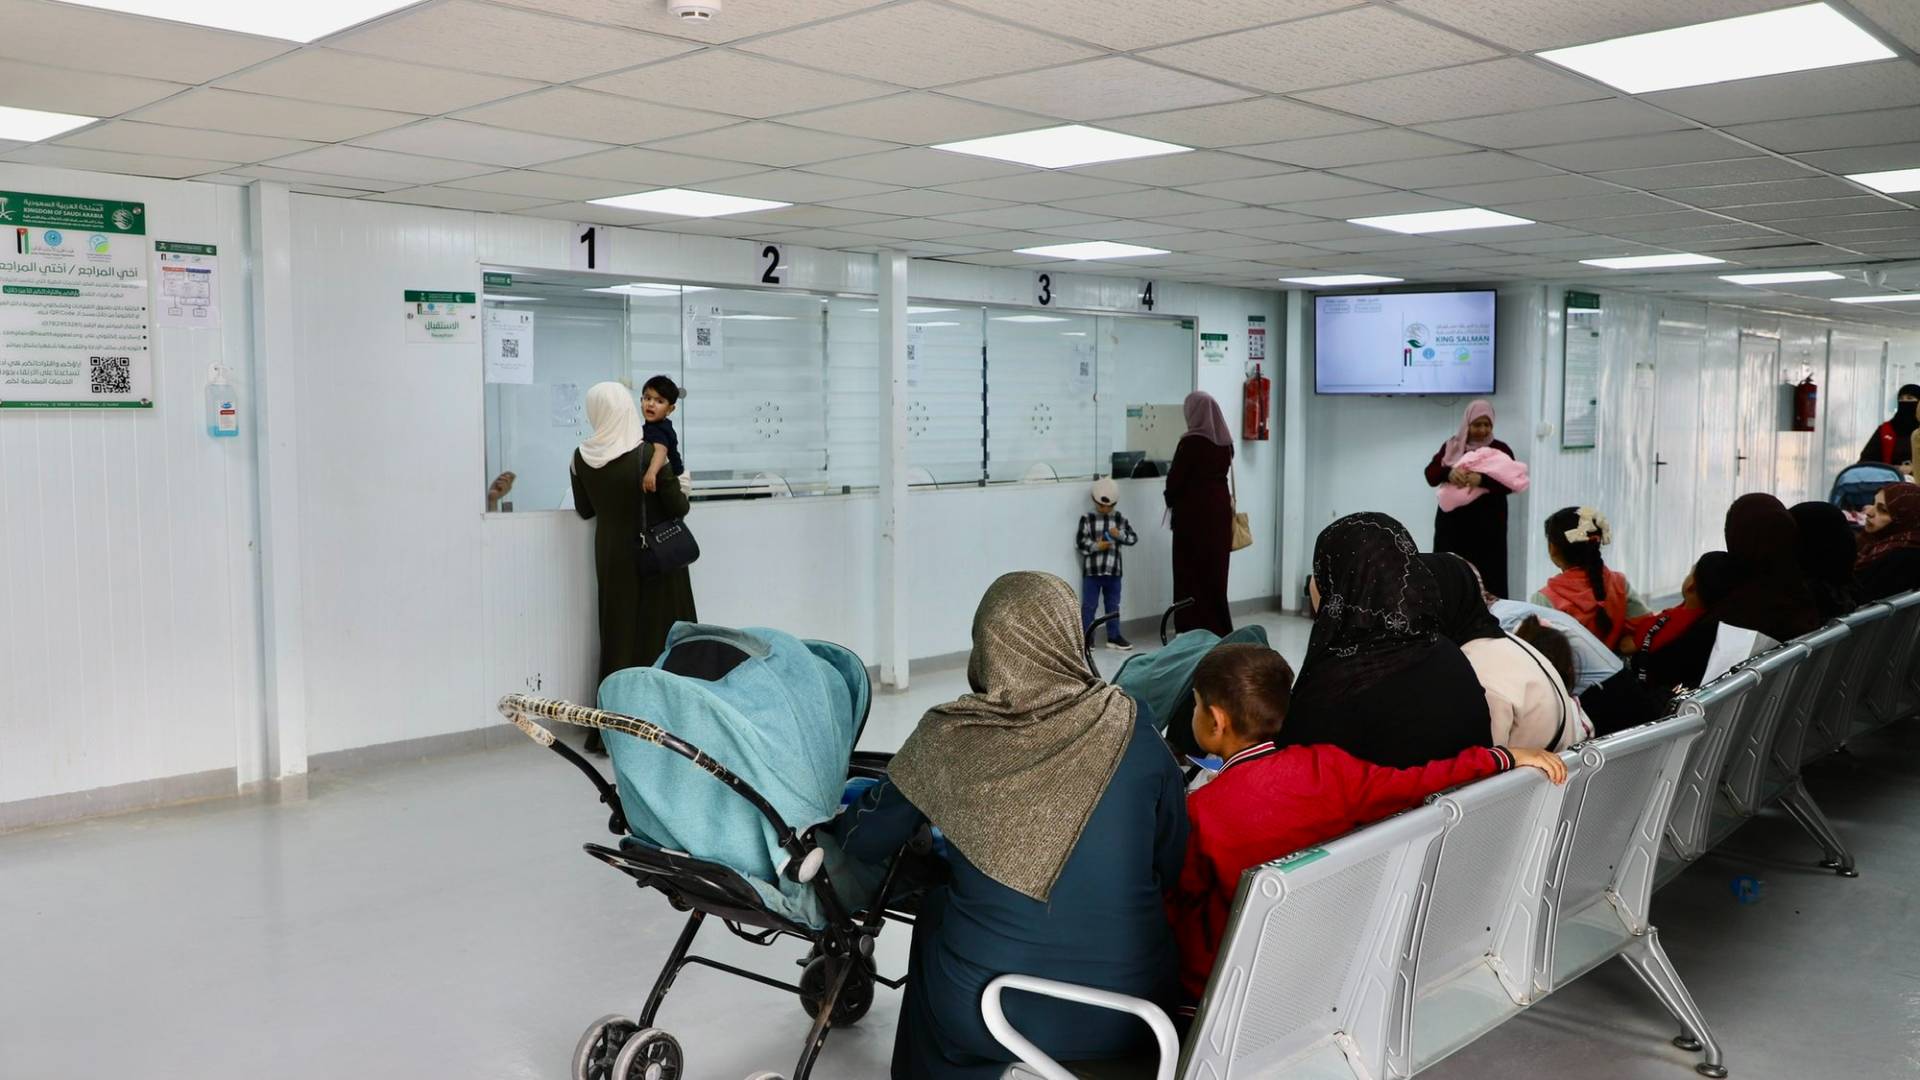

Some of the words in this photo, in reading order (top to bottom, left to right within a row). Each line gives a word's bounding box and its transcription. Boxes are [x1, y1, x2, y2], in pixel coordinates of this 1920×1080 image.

[580, 227, 596, 269] 1
[0, 261, 37, 273] المراجع
[39, 262, 66, 275] أختي
[78, 265, 115, 278] المراجع
[761, 246, 780, 284] 2
[117, 267, 138, 280] أخي
[1038, 274, 1051, 305] 3
[1142, 281, 1154, 311] 4
[1457, 335, 1490, 343] SALMAN
